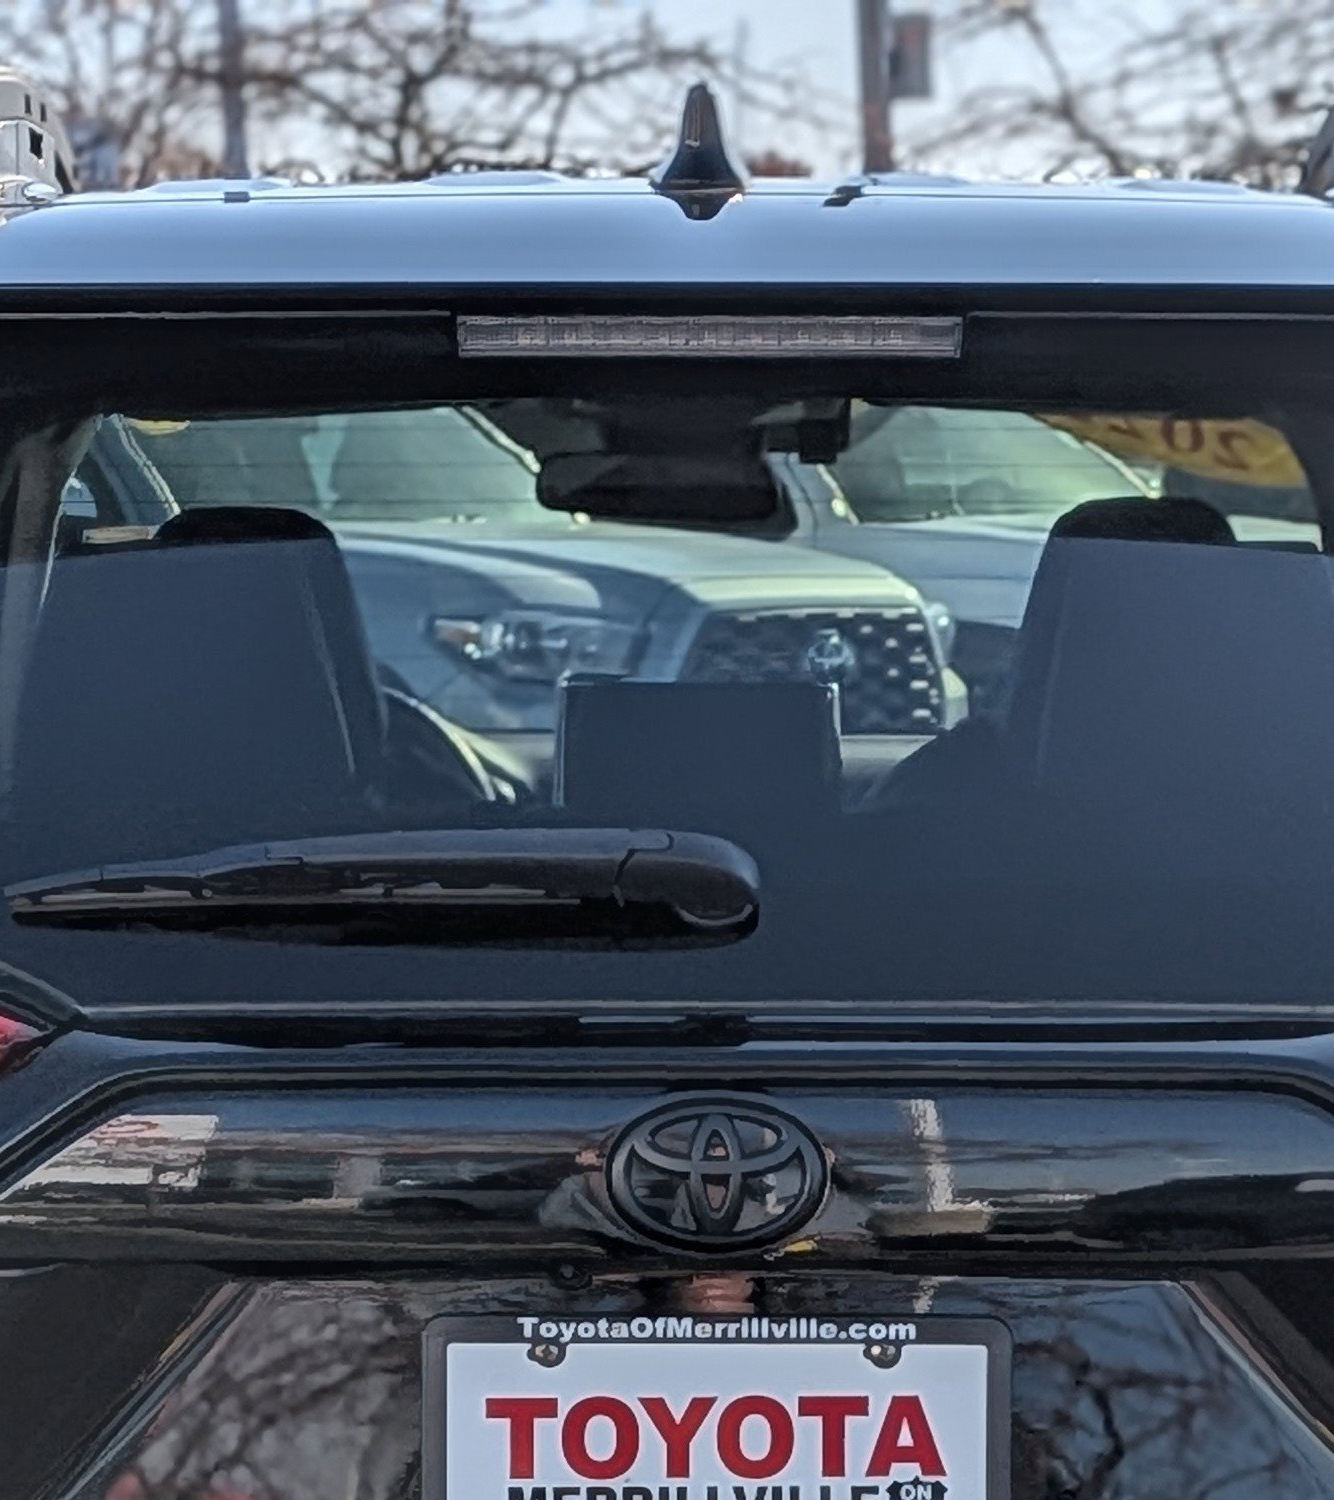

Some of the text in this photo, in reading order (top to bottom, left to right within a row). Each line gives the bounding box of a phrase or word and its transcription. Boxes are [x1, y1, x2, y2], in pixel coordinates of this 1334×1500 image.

[516, 1316, 917, 1343] ToyotaOfMerrillville.com
[485, 1394, 948, 1480] TOYOTA
[899, 1486, 933, 1500] ON
